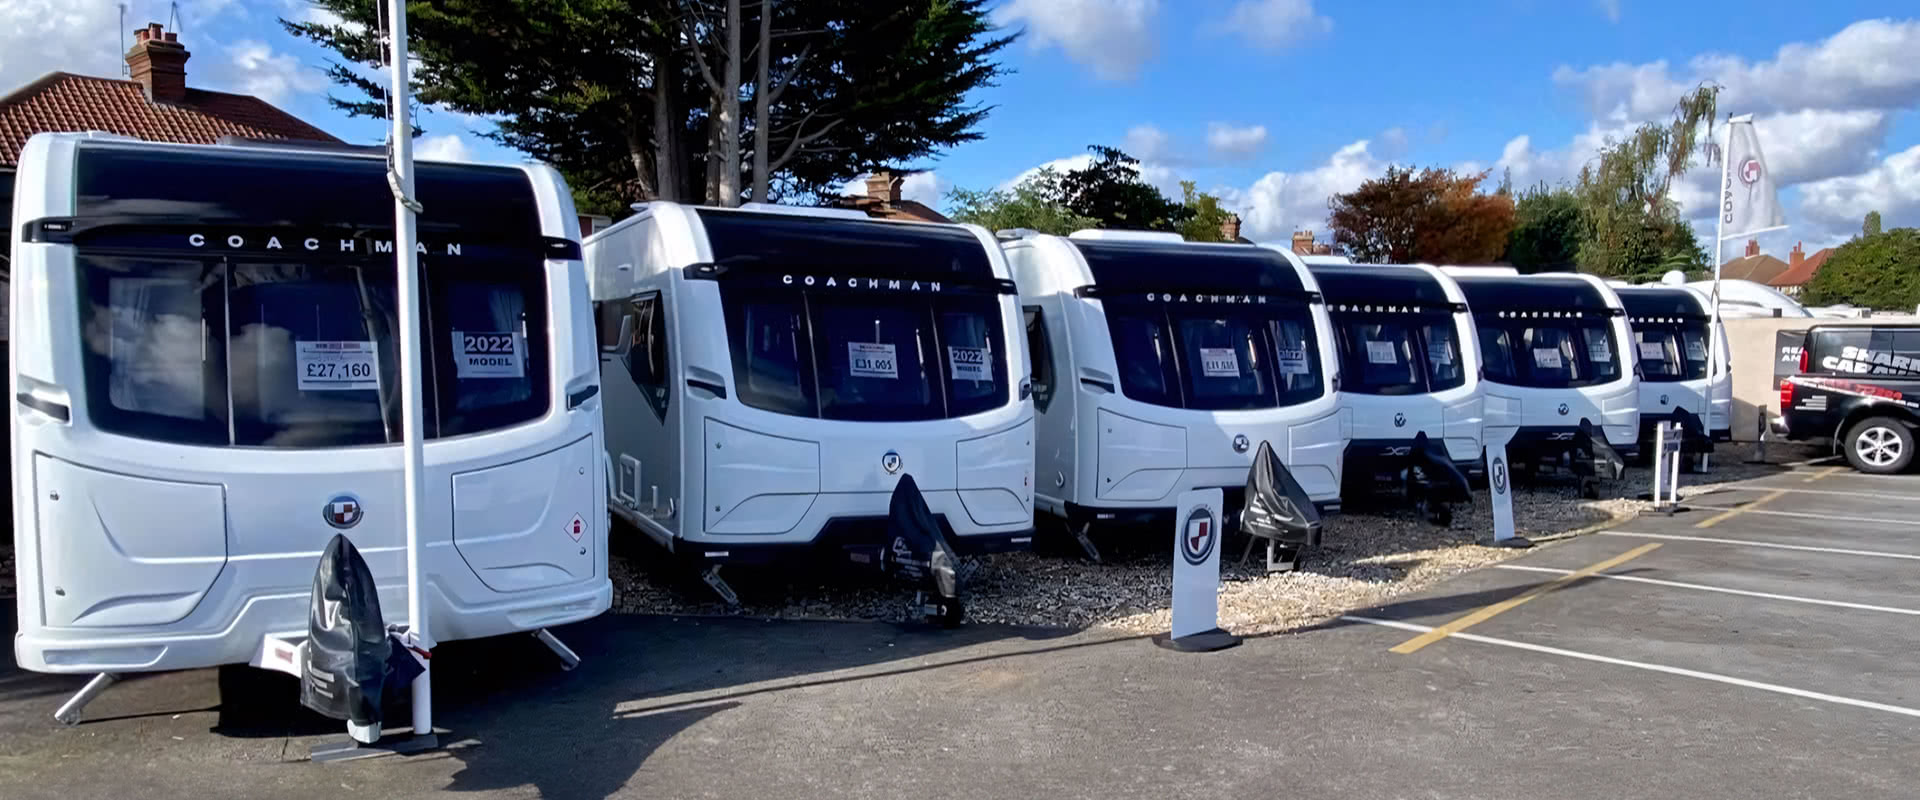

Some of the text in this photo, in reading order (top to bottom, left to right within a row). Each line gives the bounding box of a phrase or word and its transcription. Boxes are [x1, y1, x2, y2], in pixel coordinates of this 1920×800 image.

[188, 233, 462, 256] COACHMAN
[782, 274, 941, 292] COACHMAN
[1146, 292, 1266, 304] COACHMAN
[464, 335, 513, 352] 2022
[952, 350, 983, 362] 2022
[306, 362, 371, 380] £27,160
